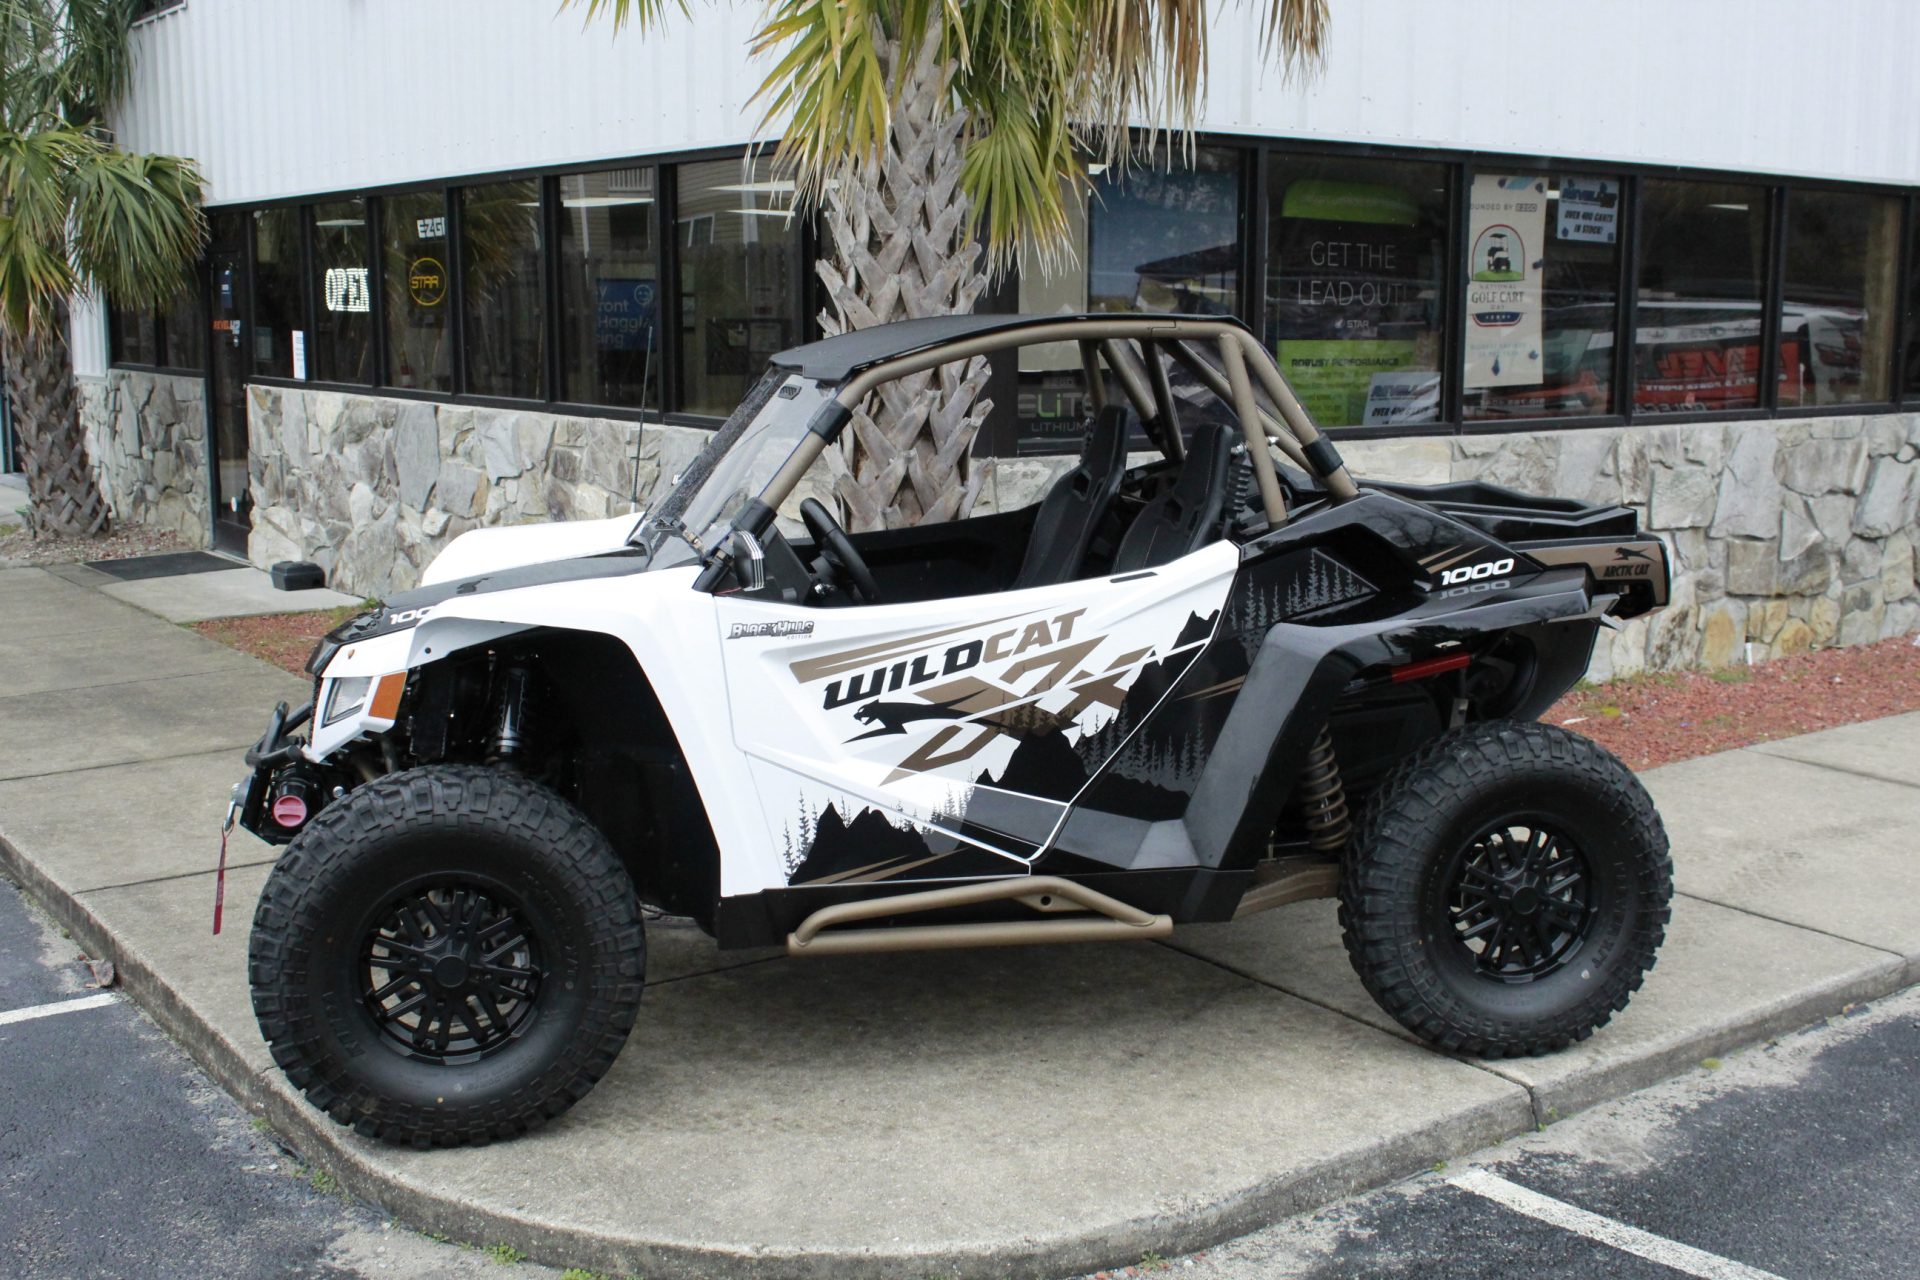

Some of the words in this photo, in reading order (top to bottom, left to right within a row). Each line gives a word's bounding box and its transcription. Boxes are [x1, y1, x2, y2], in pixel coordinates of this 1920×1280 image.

[1310, 241, 1351, 267] GET
[1356, 243, 1396, 269] THE
[1298, 280, 1354, 306] LEAD
[1471, 292, 1498, 304] GOLF
[1500, 291, 1526, 303] CART
[1031, 421, 1088, 432] LITHIUM
[1441, 558, 1515, 586] 1000
[1603, 565, 1634, 577] ARCTIC
[1635, 563, 1651, 576] CAT
[823, 607, 1088, 711] WILDCAT
